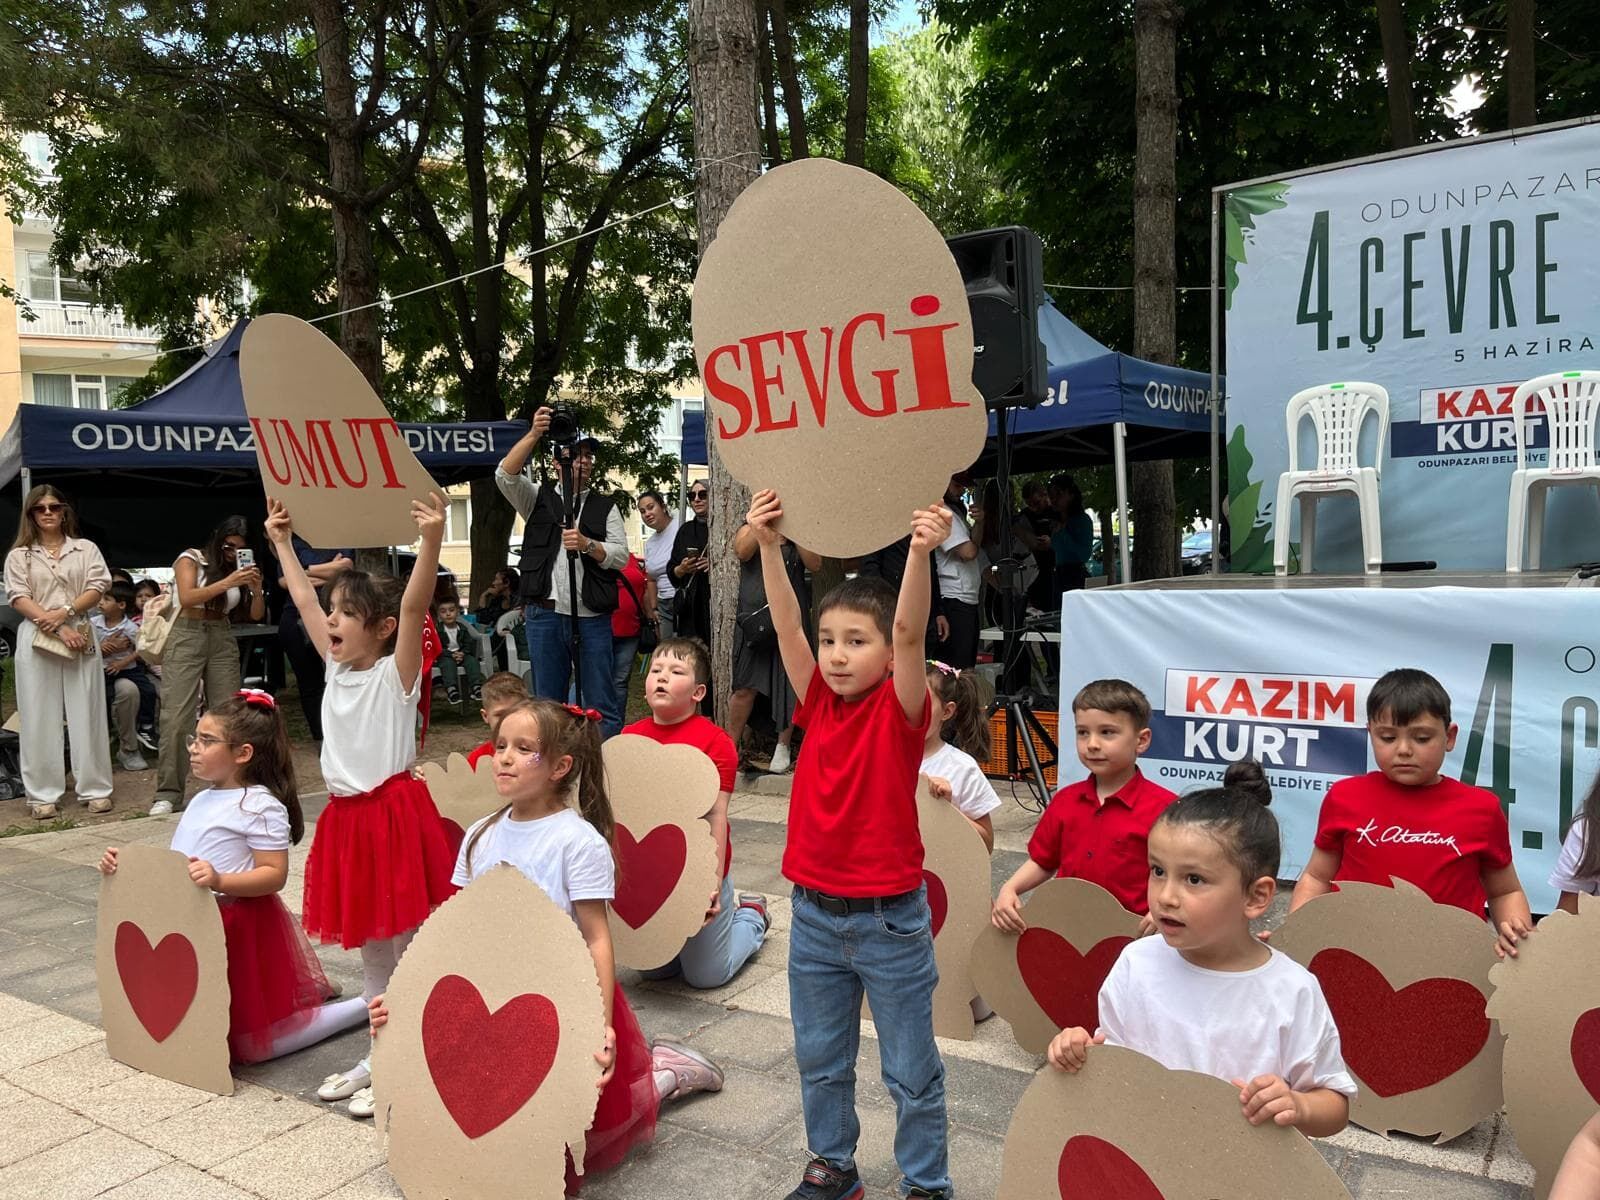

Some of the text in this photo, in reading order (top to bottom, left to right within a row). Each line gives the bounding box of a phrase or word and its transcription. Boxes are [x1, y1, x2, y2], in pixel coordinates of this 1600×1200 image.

[1454, 337, 1594, 362] 5 HAZİRA
[704, 295, 970, 440] SEVGİ
[72, 423, 495, 452] ODUNPAZ DİYESİ
[1437, 419, 1543, 452] KURT
[249, 418, 406, 488] UMUT
[1418, 457, 1490, 468] ODUNPAZARI
[1185, 676, 1356, 723] KAZIM
[1184, 720, 1320, 767] KURT
[1159, 766, 1224, 782] ODUNPAZ
[1265, 775, 1322, 791] LEDİYE
